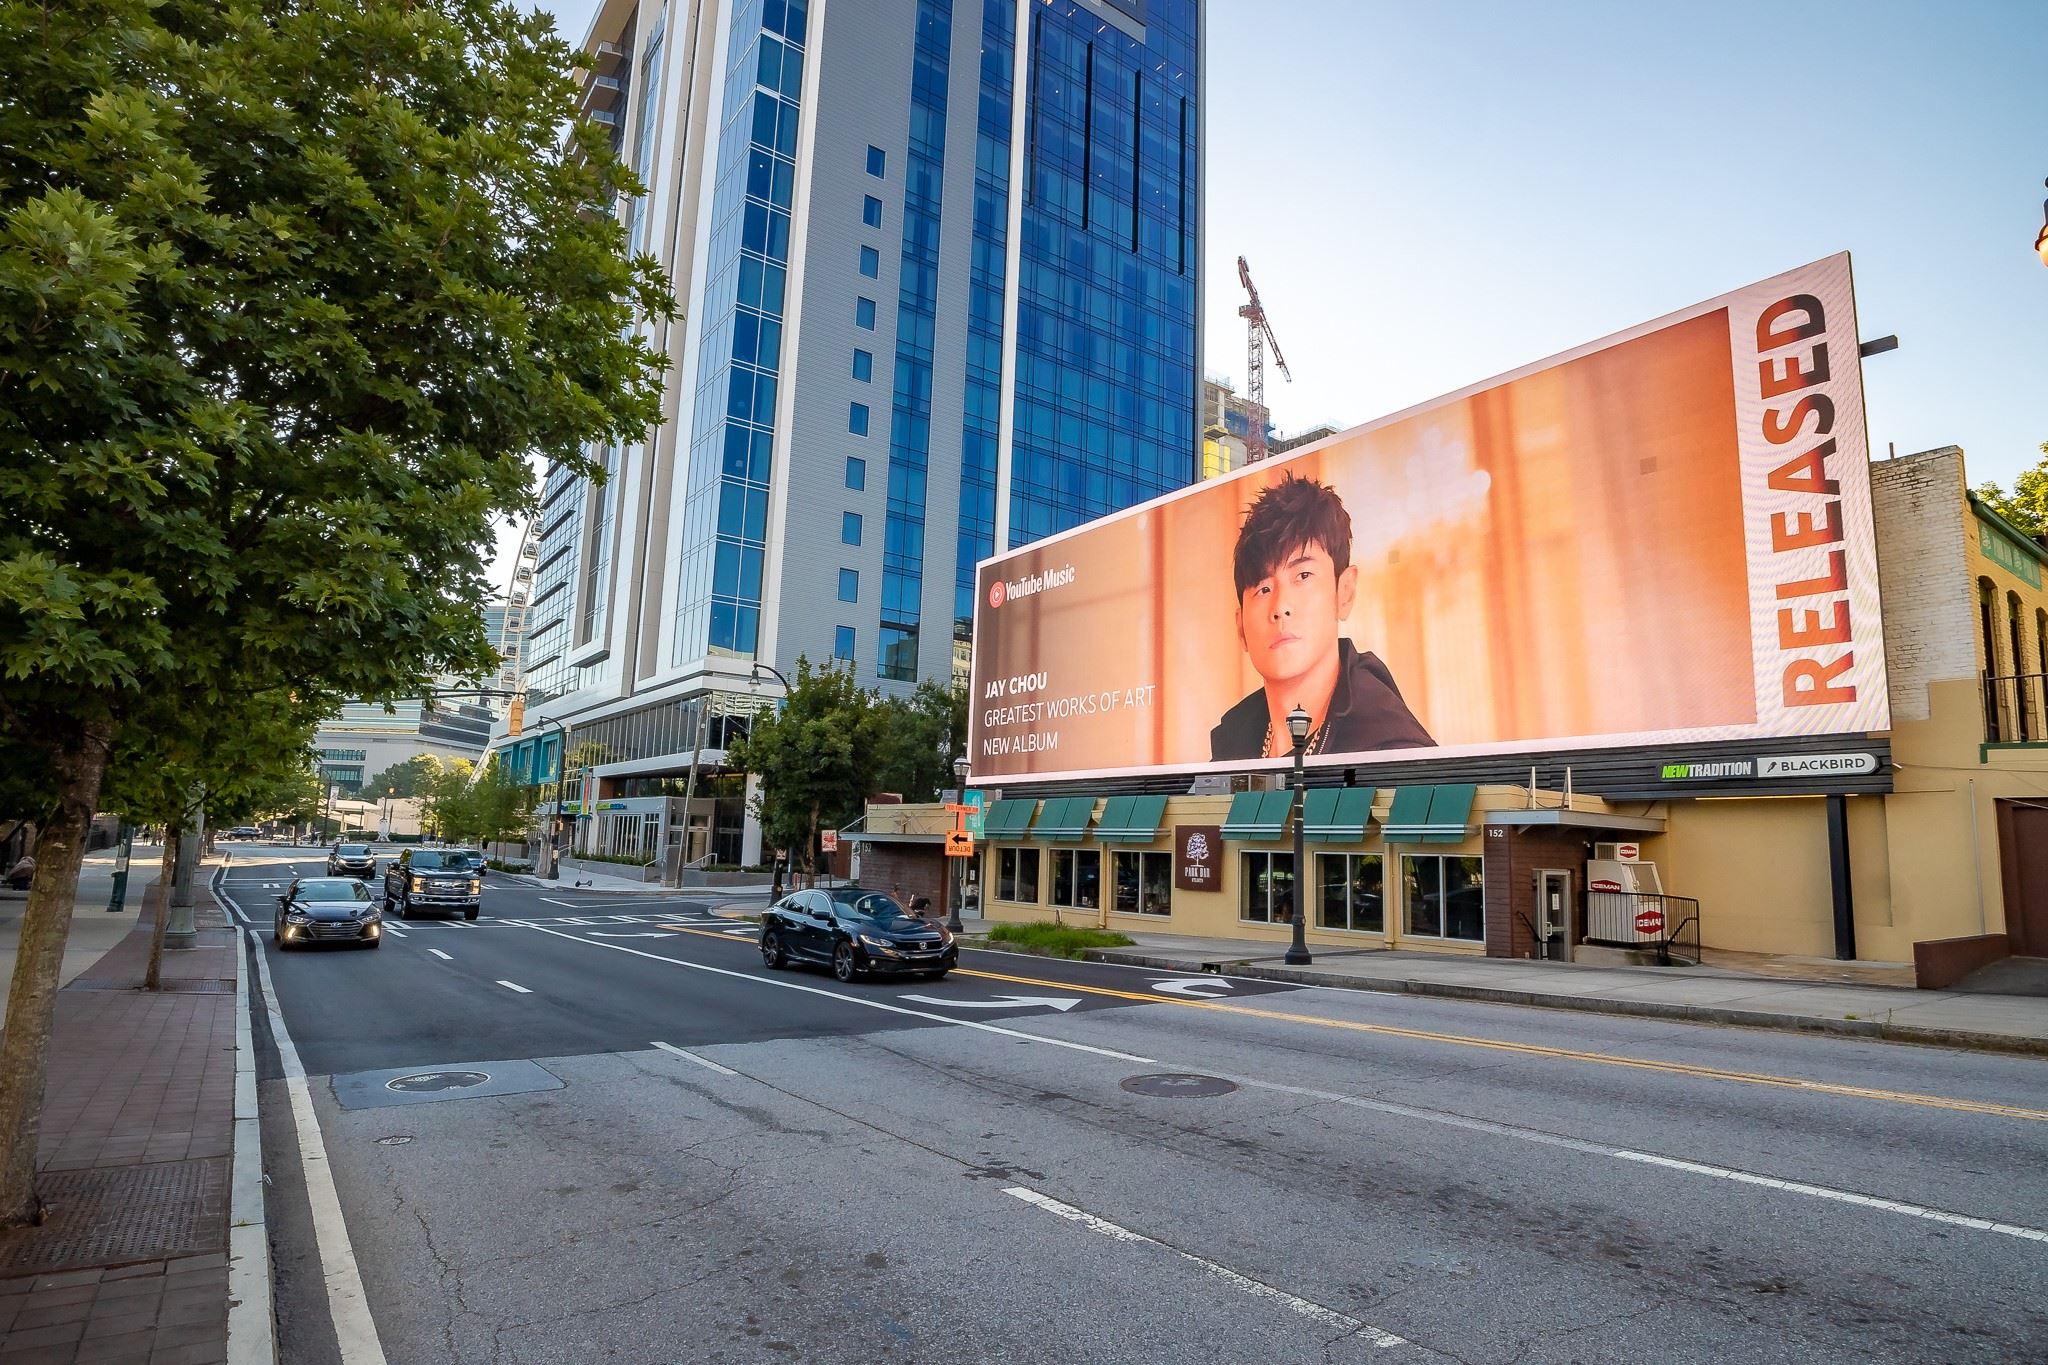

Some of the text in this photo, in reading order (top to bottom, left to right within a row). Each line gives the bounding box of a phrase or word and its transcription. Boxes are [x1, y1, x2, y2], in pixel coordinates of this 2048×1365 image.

[1756, 294, 1857, 707] RELEASED
[1006, 563, 1075, 601] YouTube Music
[985, 671, 1048, 699] JAY CHOU
[984, 685, 1156, 728] GREATEST WORKS OF ART
[983, 731, 1059, 756] NEW ALBUM
[1781, 758, 1866, 772] BLACKBIRD
[1489, 829, 1504, 838] 152
[862, 842, 872, 853] 152
[948, 845, 971, 853] DETOUR
[1184, 866, 1210, 878] PARK BAR
